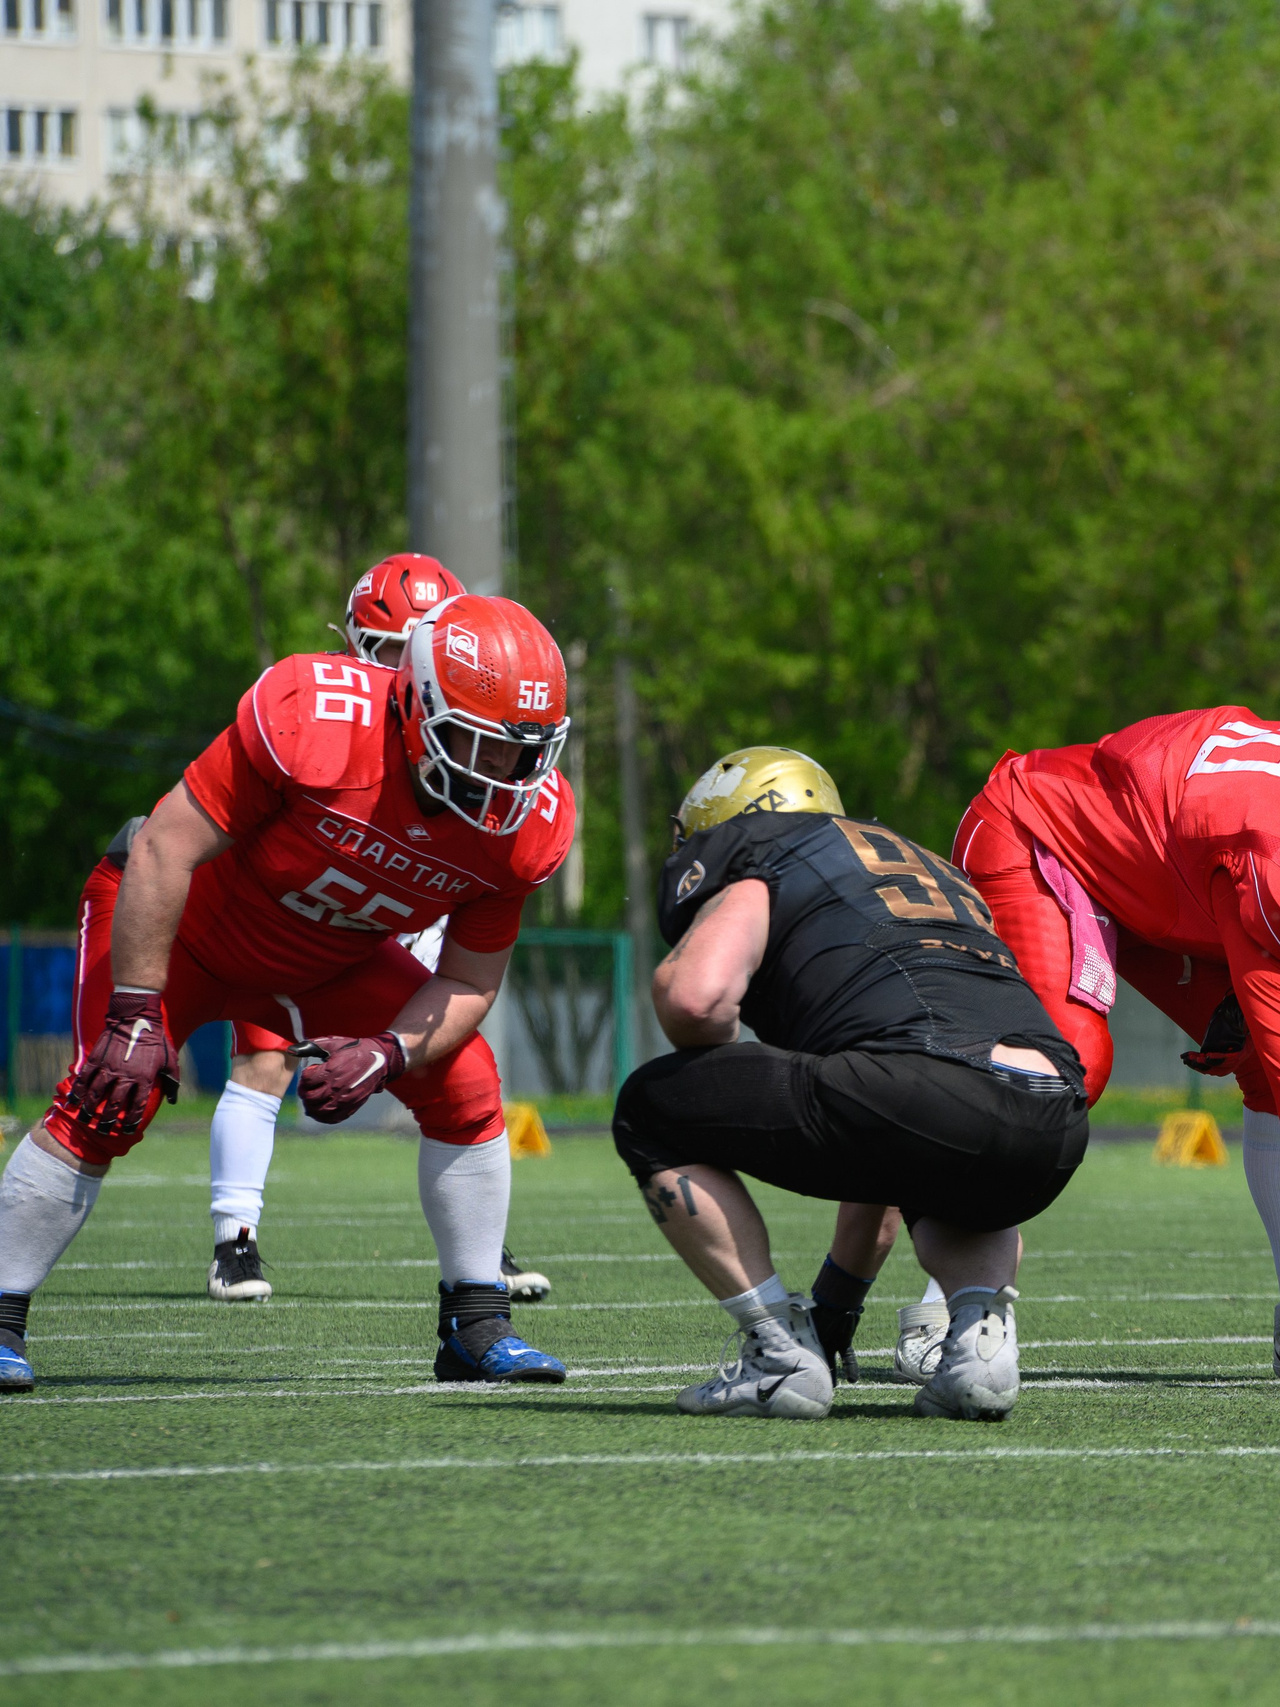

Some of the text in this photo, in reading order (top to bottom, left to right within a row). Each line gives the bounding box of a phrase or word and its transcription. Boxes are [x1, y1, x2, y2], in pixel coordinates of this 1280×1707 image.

[415, 581, 438, 602] 30
[312, 661, 372, 728] 56
[517, 680, 549, 711] 56
[315, 816, 471, 894] СПАРТАК
